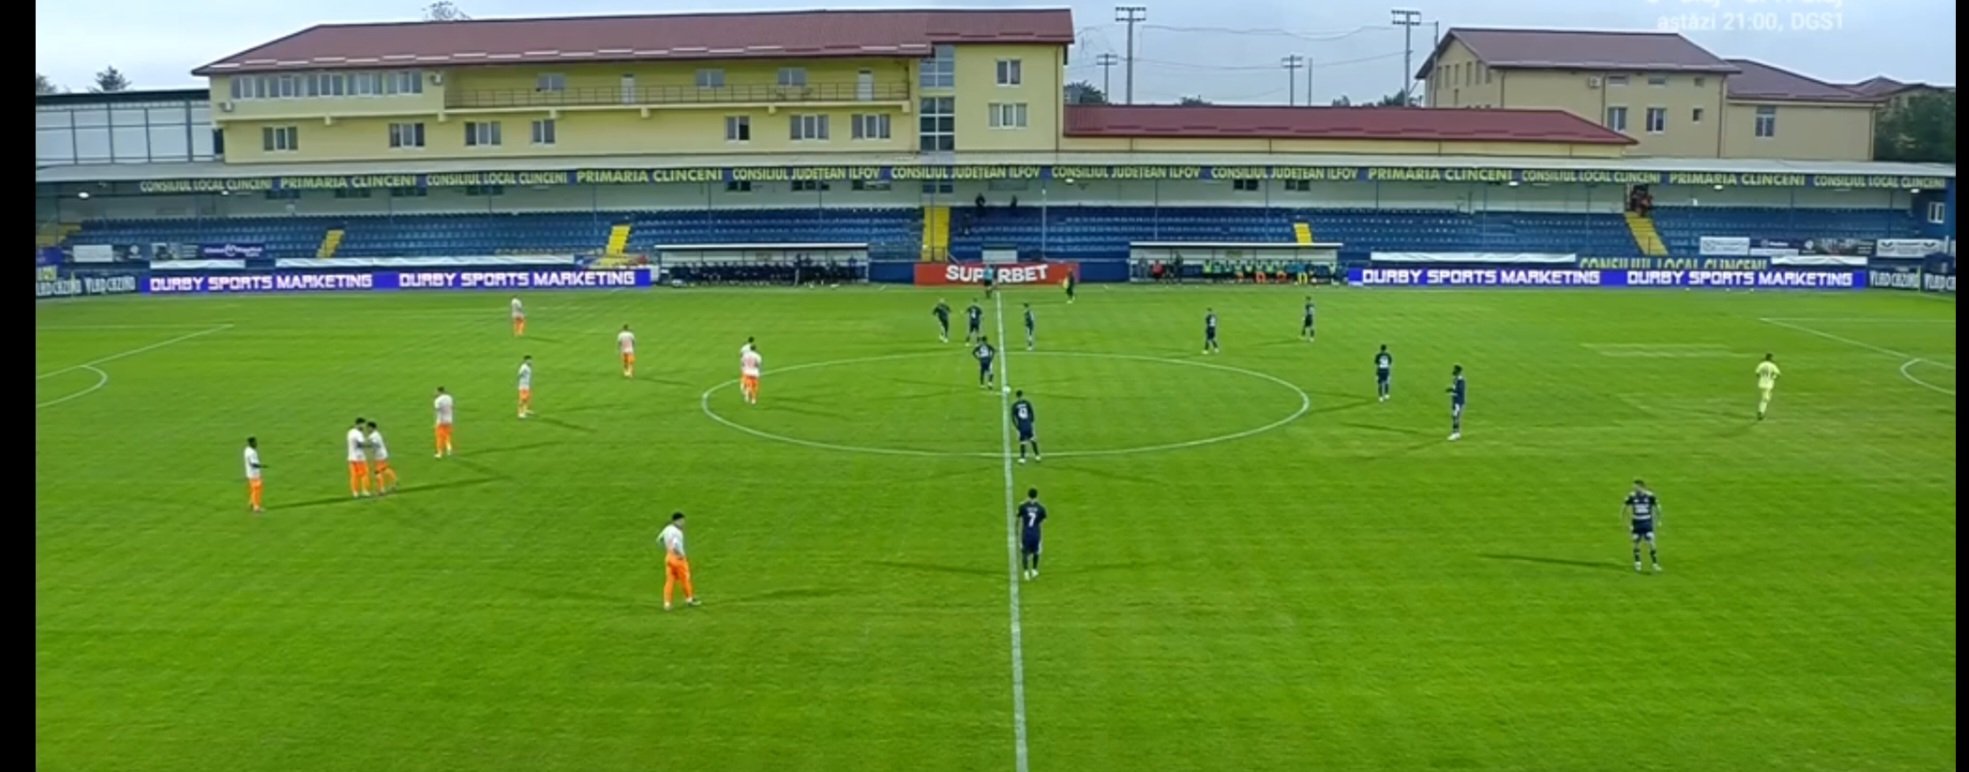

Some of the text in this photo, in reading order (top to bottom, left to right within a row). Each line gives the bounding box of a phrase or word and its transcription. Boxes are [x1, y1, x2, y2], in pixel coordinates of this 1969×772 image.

[426, 172, 567, 186] CONSILIUL LOCAL CLINCENI
[577, 169, 722, 183] PRIMARIA CLINCENI
[733, 168, 788, 180] CONSILIUL
[849, 167, 880, 179] ILFOV
[891, 166, 948, 179] CONSILIUL
[1009, 166, 1040, 178] ILFOV
[1051, 166, 1107, 178] CONSILIUL
[1169, 166, 1200, 178] ILFOV
[1211, 167, 1267, 179] CONSILIUL
[1327, 167, 1358, 179] ILFOV
[1368, 168, 1512, 181] PRIMARIA CLINCENI
[1521, 170, 1660, 184] CONSILIUL LOCAL CLINCENI
[1669, 172, 1805, 186] PRIMARIA CLINCENI
[140, 178, 272, 192] CONSILIUL LOCAL CLINCENI
[280, 175, 417, 189] PRIMARIA CLINCENI
[1813, 175, 1945, 189] CONSILIUL LOCAL CLINCENI
[399, 270, 635, 287] DURBY SPORTS MARKETING
[946, 265, 1048, 283] SUPRBET
[1363, 269, 1600, 285] DURBY SPORTS MARKETING
[1627, 270, 1852, 287] DURBY SPORTS MARKETING
[150, 273, 372, 291] DURBY SPORTS MARKETING
[1027, 511, 1036, 527] 7
